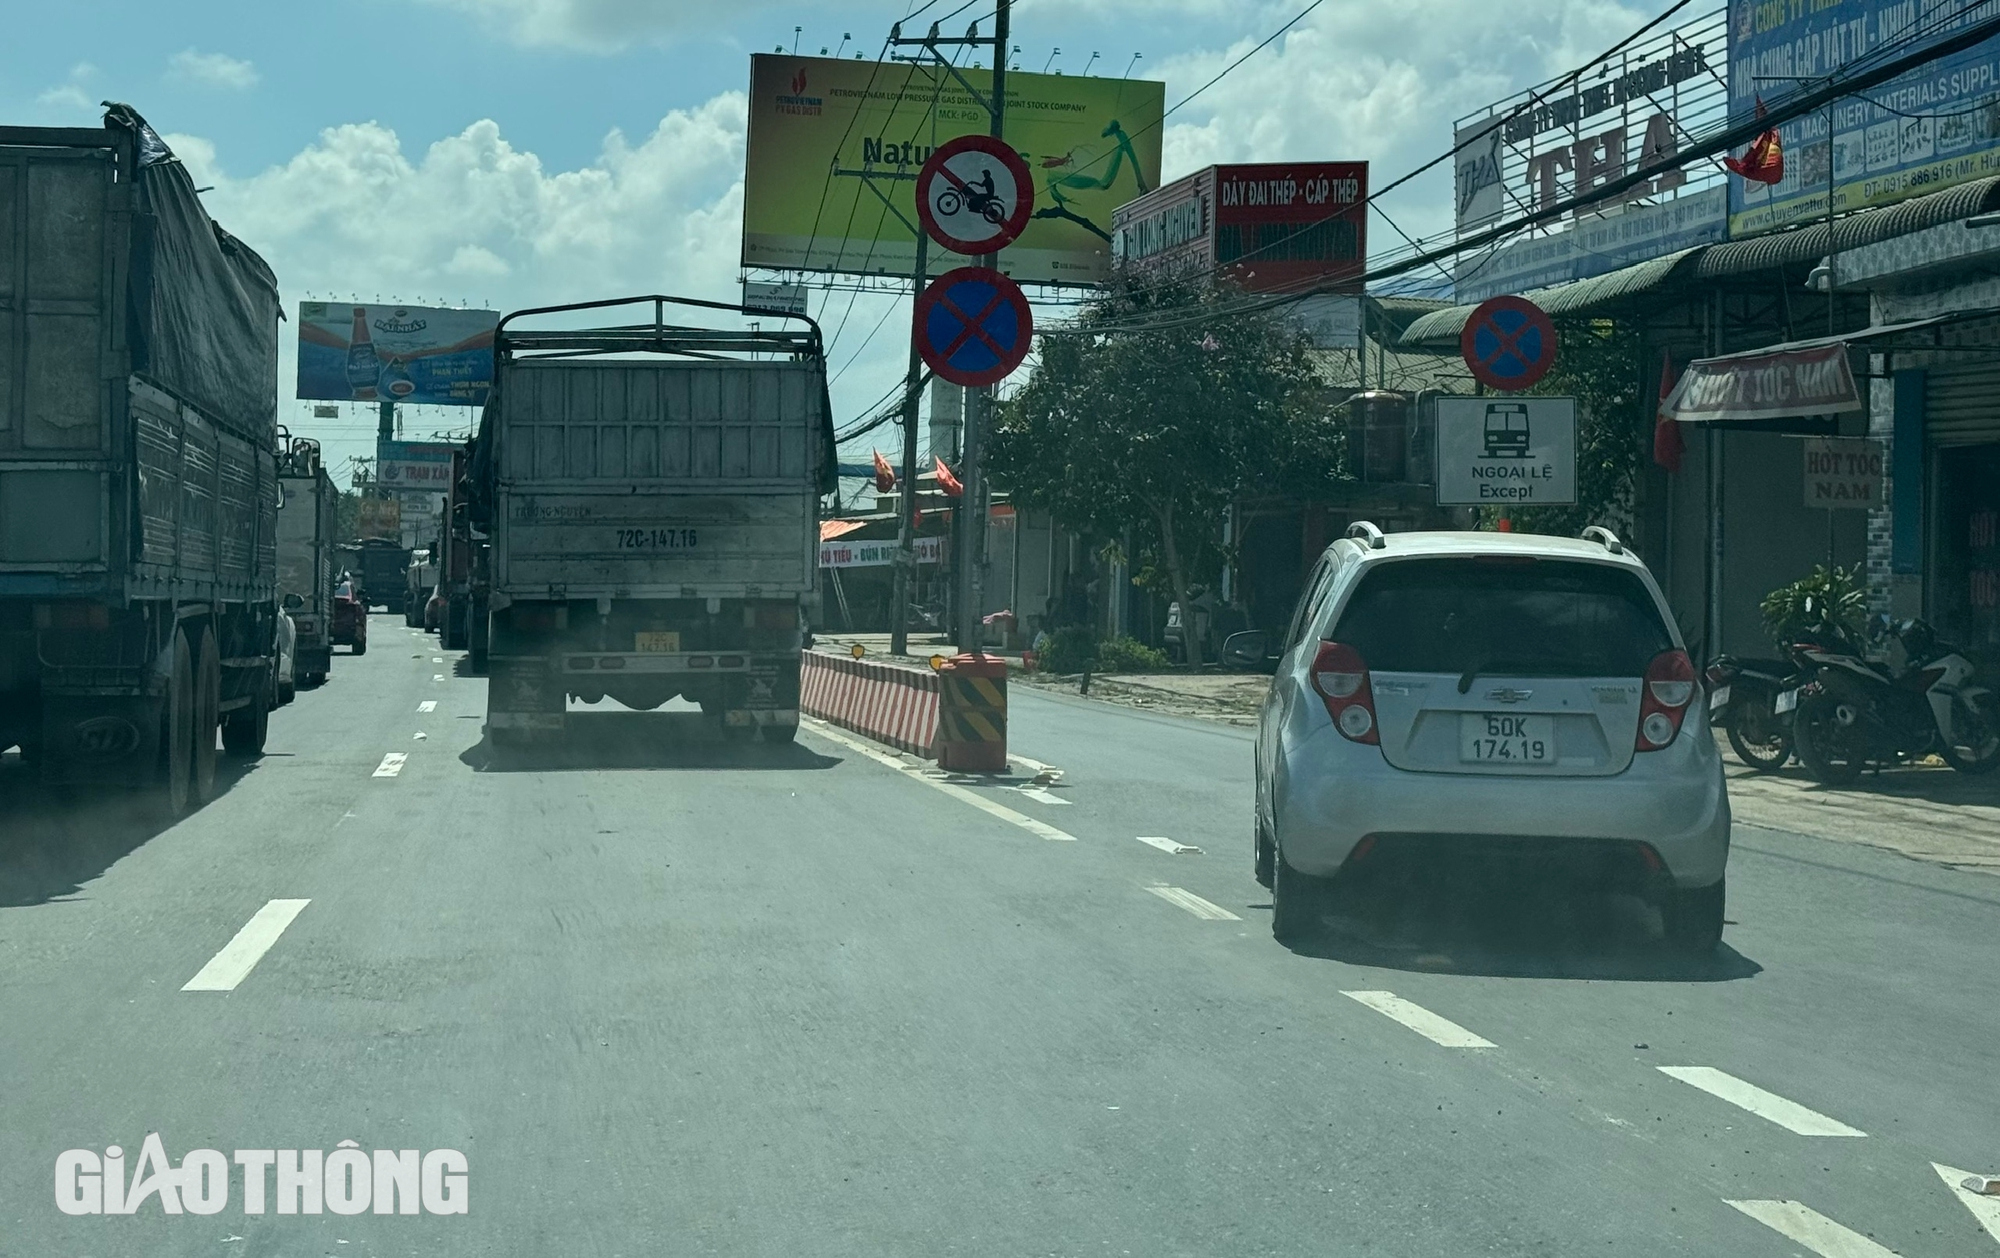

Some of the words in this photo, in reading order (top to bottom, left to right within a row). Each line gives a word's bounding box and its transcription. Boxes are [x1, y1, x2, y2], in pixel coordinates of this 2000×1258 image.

[1761, 43, 1792, 91] CUNG
[1795, 20, 1819, 75] CẤP
[941, 94, 955, 104] GAS
[1007, 98, 1025, 109] JOINT
[1026, 100, 1050, 110] STOCK
[1050, 102, 1086, 114] COMPANY
[1802, 102, 1871, 141] MACHINERY
[1873, 84, 1947, 119] MATERIALS
[961, 111, 979, 122] PGD
[863, 136, 937, 168] Natu
[1526, 113, 1688, 226] THA
[1884, 175, 1908, 195] 0915
[1911, 168, 1930, 191] 886
[1932, 163, 1952, 184] 916
[1222, 174, 1246, 206] DÂY
[1249, 180, 1267, 206] ĐAI
[1270, 173, 1297, 205] THÉP
[1305, 173, 1329, 205] CÁP
[1333, 171, 1359, 203] THÉP
[1795, 358, 1847, 399] NAM
[1472, 466, 1525, 481] NGOẠI
[1531, 463, 1553, 482] LỆ
[1480, 483, 1534, 501] Except
[1815, 481, 1870, 500] NAM
[616, 528, 697, 549] 72C-147.16
[1486, 716, 1528, 738] 60K
[1472, 740, 1545, 760] 174.19
